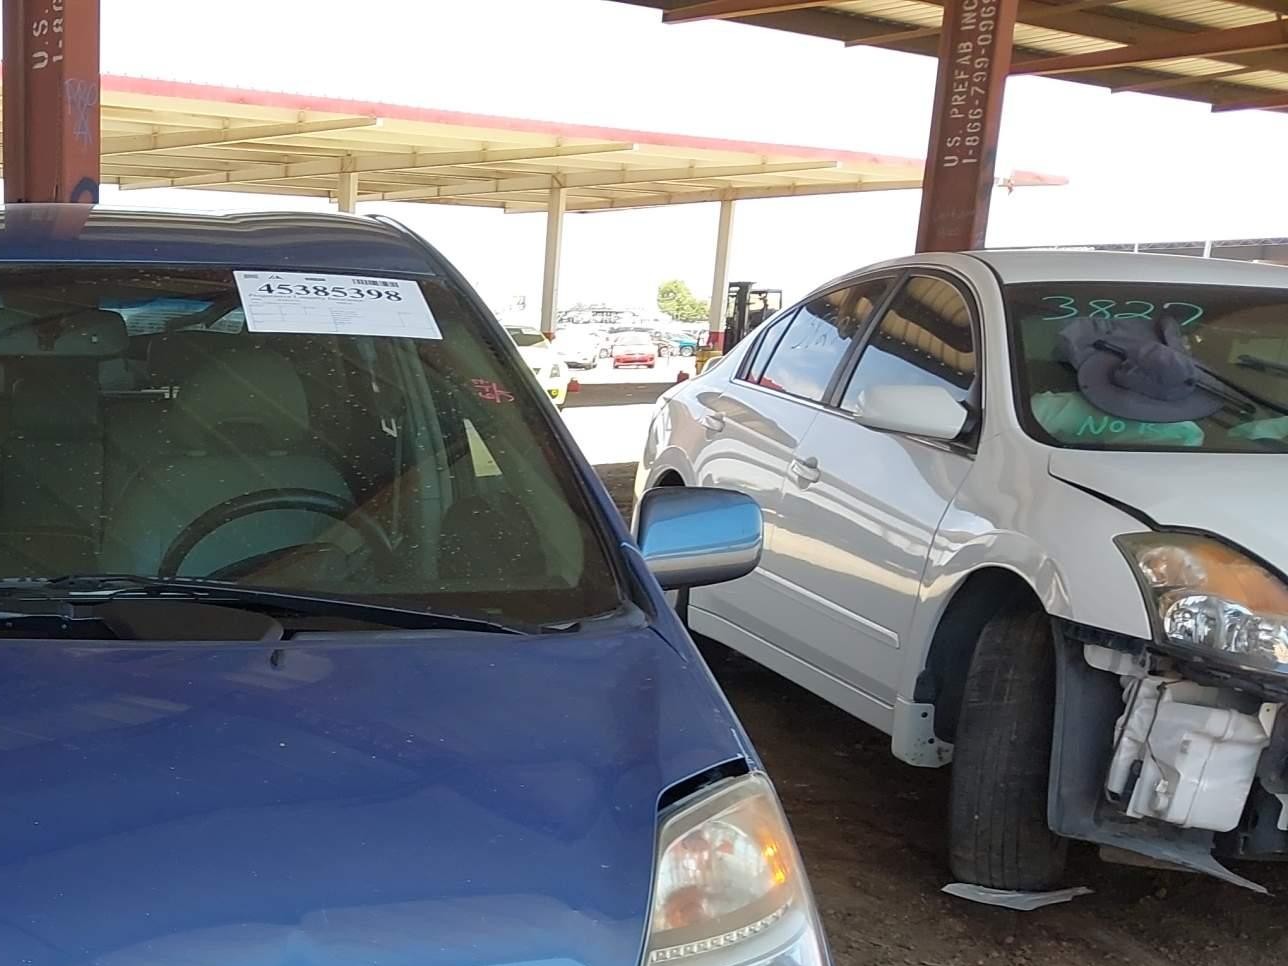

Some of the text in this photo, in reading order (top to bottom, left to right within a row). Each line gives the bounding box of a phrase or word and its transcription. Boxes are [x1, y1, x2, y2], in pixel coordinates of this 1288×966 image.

[950, 41, 973, 119] PREFAB
[962, 0, 997, 164] 1-866-799-096
[258, 283, 403, 302] 45385398
